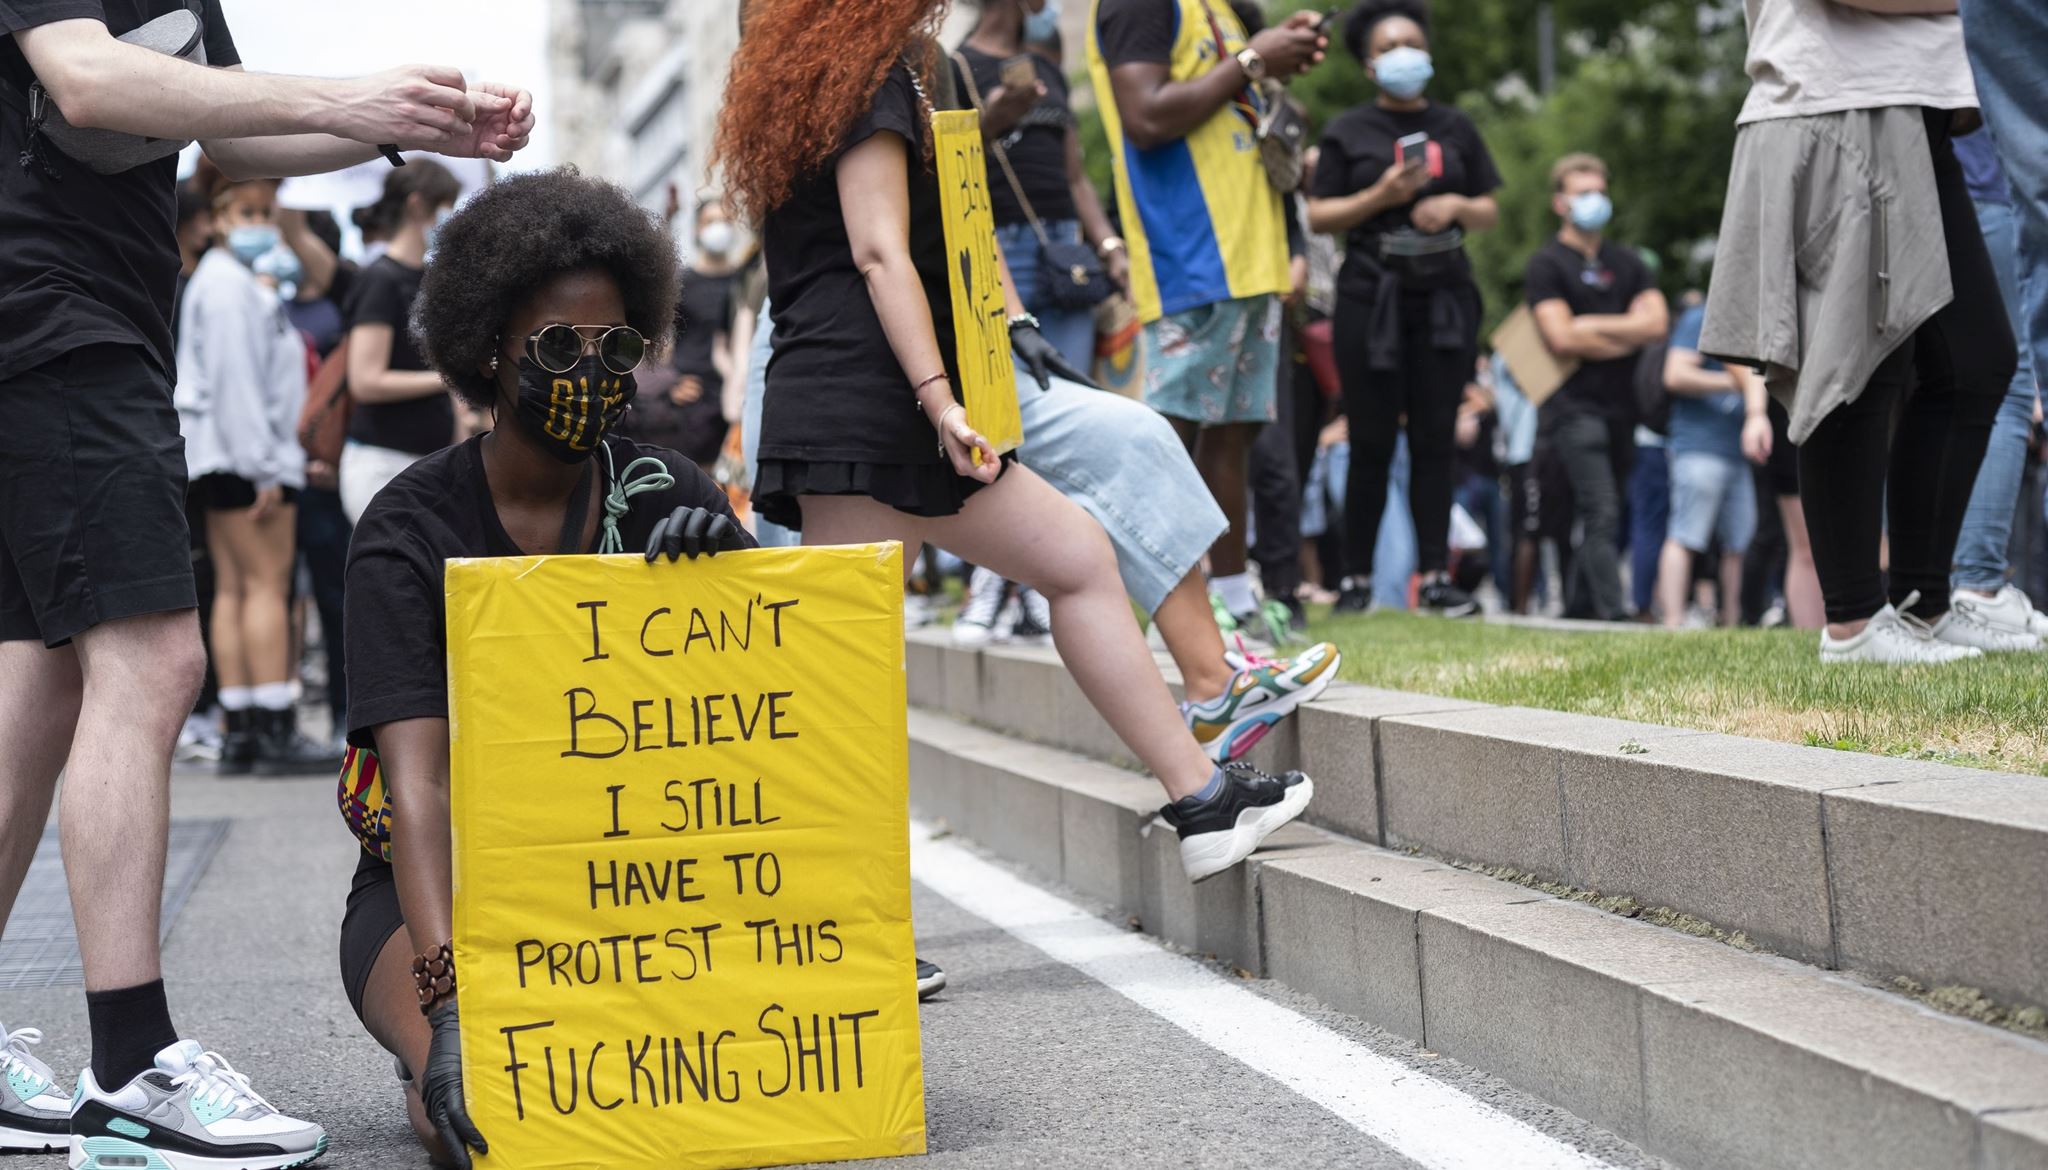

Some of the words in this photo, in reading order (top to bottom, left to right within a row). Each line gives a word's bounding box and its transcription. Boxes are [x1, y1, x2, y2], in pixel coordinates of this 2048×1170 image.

[577, 601, 609, 662] I
[641, 593, 799, 656] CAN'T
[561, 688, 799, 759] BELIEVE
[603, 785, 629, 838] I
[661, 778, 780, 832] STILL
[588, 859, 705, 909] HAVE
[723, 852, 781, 897] TO
[515, 923, 721, 988] PROTEST
[744, 919, 842, 966] THIS
[500, 1020, 739, 1120] FUCKING
[758, 1004, 879, 1097] SHIT
